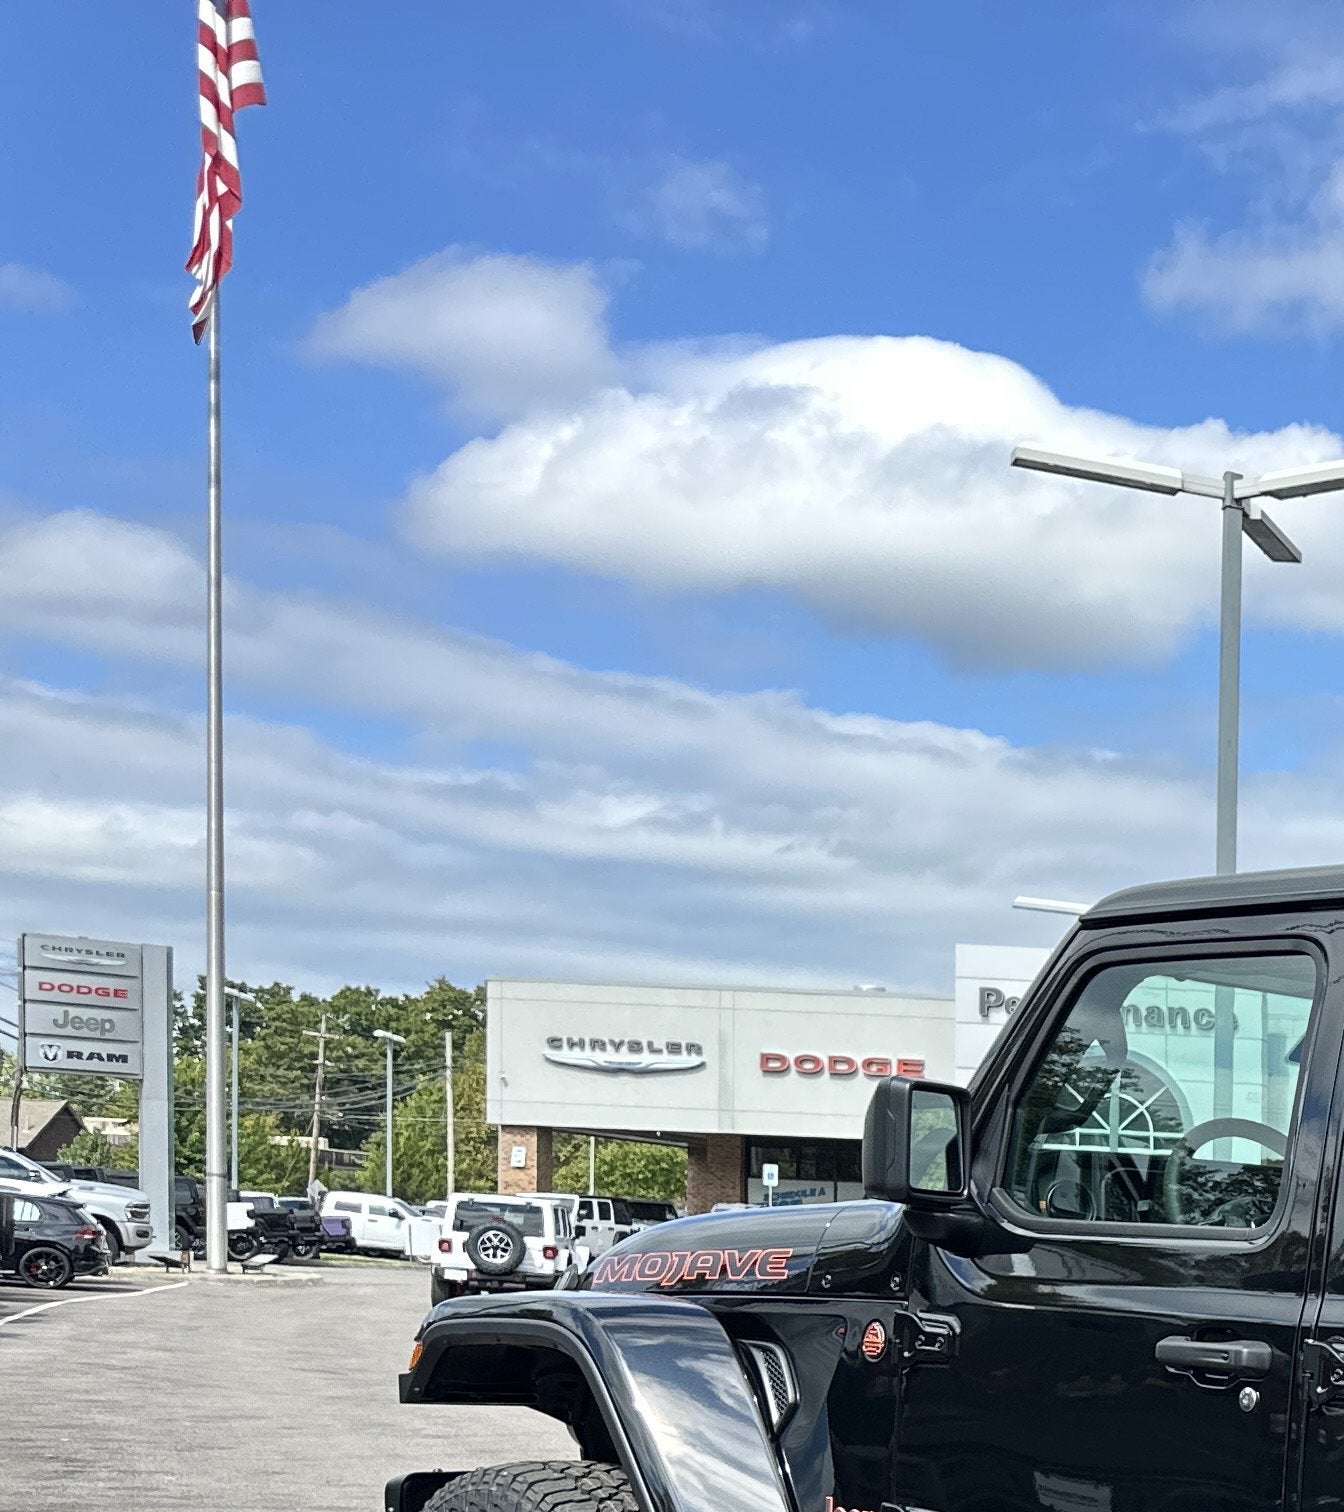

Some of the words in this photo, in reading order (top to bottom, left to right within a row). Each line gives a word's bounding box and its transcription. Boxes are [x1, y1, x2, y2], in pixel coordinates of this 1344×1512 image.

[40, 944, 126, 959] CHRYSLER
[38, 981, 128, 999] DODGE
[52, 1009, 116, 1036] Jeep
[546, 1036, 702, 1056] CHRYSLER
[66, 1050, 129, 1063] RAM
[760, 1052, 926, 1078] DODGE
[594, 1248, 794, 1287] MOJAVE
